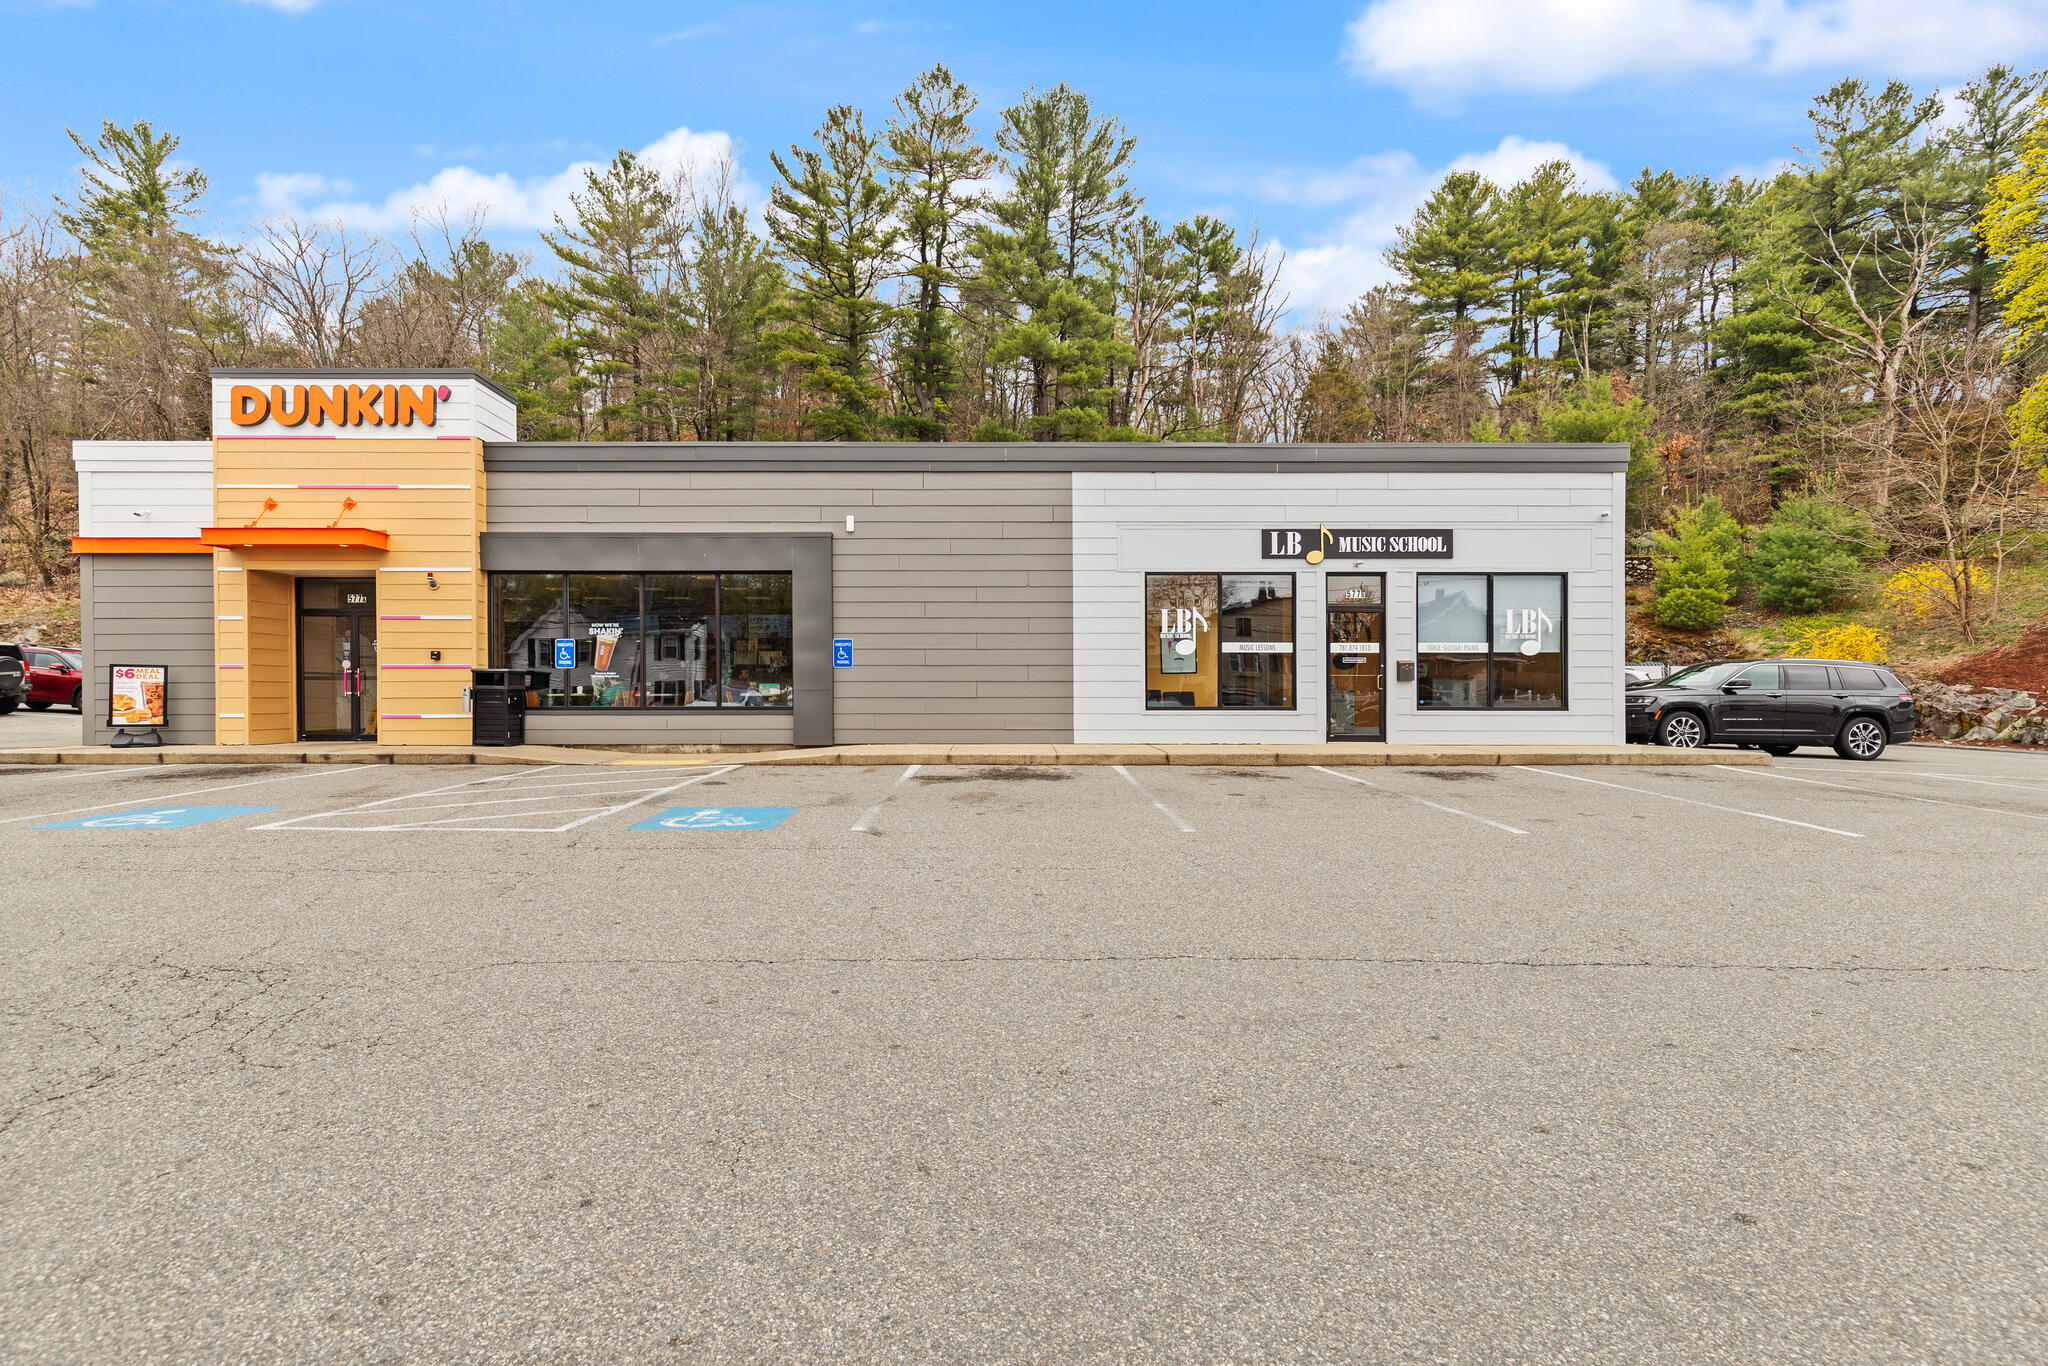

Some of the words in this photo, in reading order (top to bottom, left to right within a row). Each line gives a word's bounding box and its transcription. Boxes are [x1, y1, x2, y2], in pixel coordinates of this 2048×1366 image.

[231, 384, 451, 427] DUNKIN'
[1270, 531, 1302, 555] LB
[1339, 536, 1386, 552] MUSIC
[1389, 536, 1447, 552] SCHOOL
[1160, 608, 1192, 634] LB
[1505, 609, 1537, 633] LB
[115, 668, 136, 679] $6
